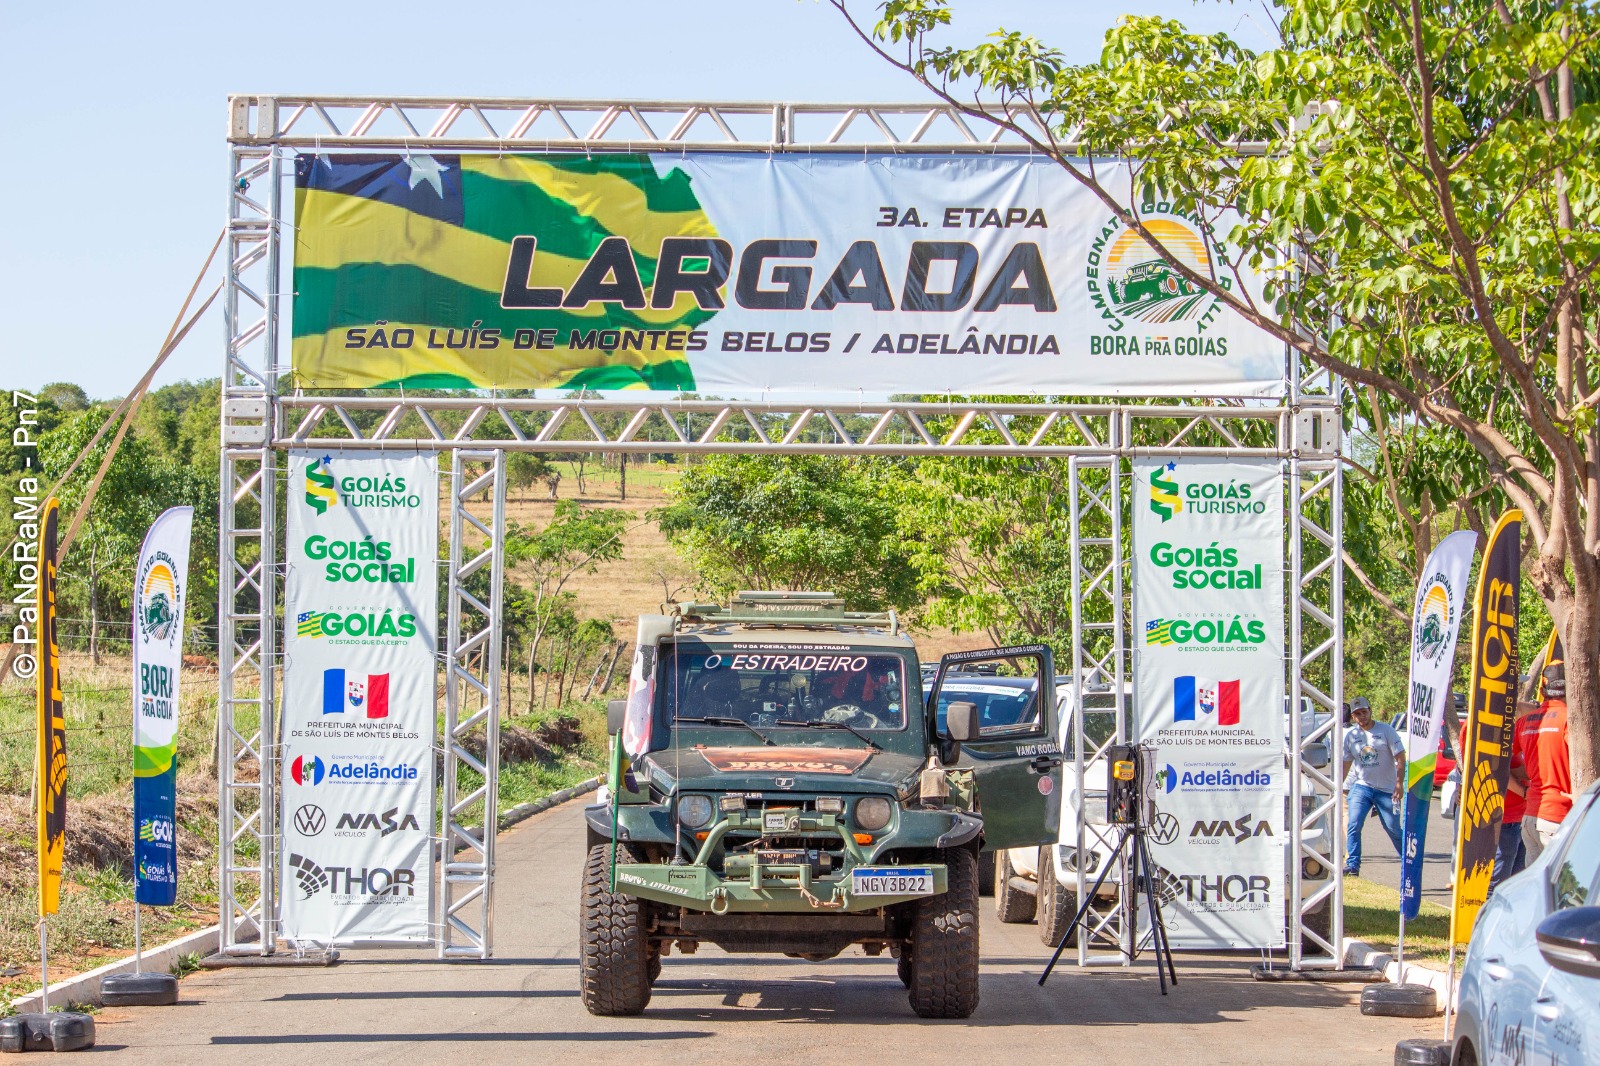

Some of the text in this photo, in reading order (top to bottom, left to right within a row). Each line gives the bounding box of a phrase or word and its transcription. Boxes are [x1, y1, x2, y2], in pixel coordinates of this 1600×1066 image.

[876, 207, 1048, 228] 3A. ETAPA
[500, 235, 1058, 312] LARGADA
[1197, 275, 1232, 335] RLLY
[345, 320, 1060, 354] SÃO LUÍS DE MONTES BELOS / ADELÂNDIA
[1090, 336, 1140, 356] BORA
[341, 473, 406, 492] GOIÁS
[1186, 479, 1251, 499] GOIÁS
[341, 494, 420, 508] TURISMO
[1186, 501, 1266, 514] TURISMO
[304, 535, 392, 560] Goiás
[1150, 542, 1238, 568] Goiás
[326, 558, 414, 582] social
[1173, 564, 1262, 590] social
[320, 608, 416, 637] GOIÁS
[1169, 615, 1265, 643] GOIÁS
[705, 654, 867, 671] O ESTRADEIRO
[1475, 577, 1514, 768] THOR
[141, 662, 174, 700] BORA
[324, 730, 342, 738] LUÍS
[1502, 696, 1514, 758] EVENTOS
[1016, 745, 1036, 756] VAMO
[329, 762, 418, 779] Adelândia
[1181, 769, 1270, 786] Adelândia
[336, 806, 420, 837] NASA
[1190, 813, 1274, 844] NASA
[324, 867, 415, 896] THOR
[649, 881, 688, 895] ADVENTURE
[862, 878, 925, 891] NGY3B22
[1180, 875, 1270, 902] THOR
